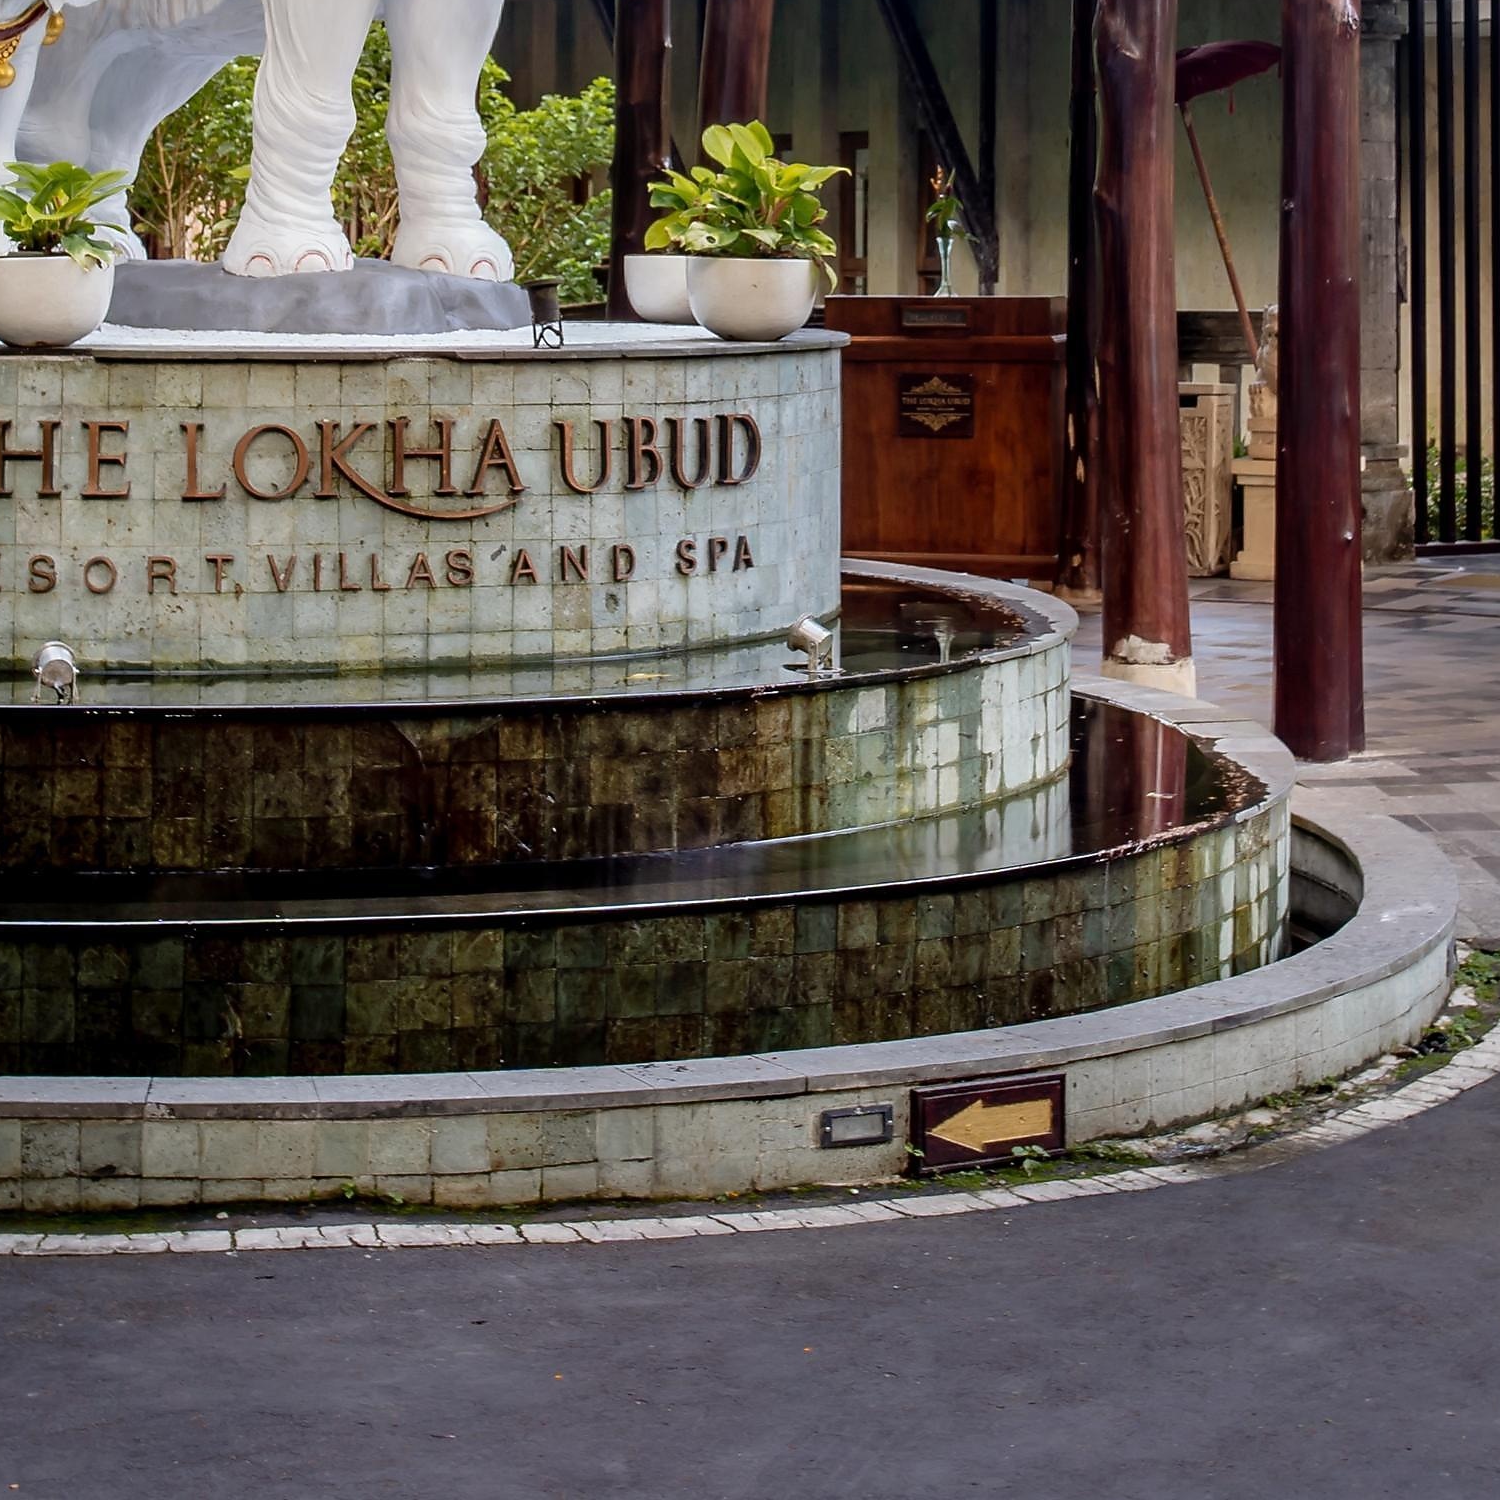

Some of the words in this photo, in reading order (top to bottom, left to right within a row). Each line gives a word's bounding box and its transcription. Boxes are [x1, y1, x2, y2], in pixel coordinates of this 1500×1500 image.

[179, 415, 528, 520] LOKHA
[551, 413, 762, 495] UBUD
[267, 549, 475, 593] VILLAS
[510, 543, 636, 585] AND
[677, 534, 757, 576] SPA
